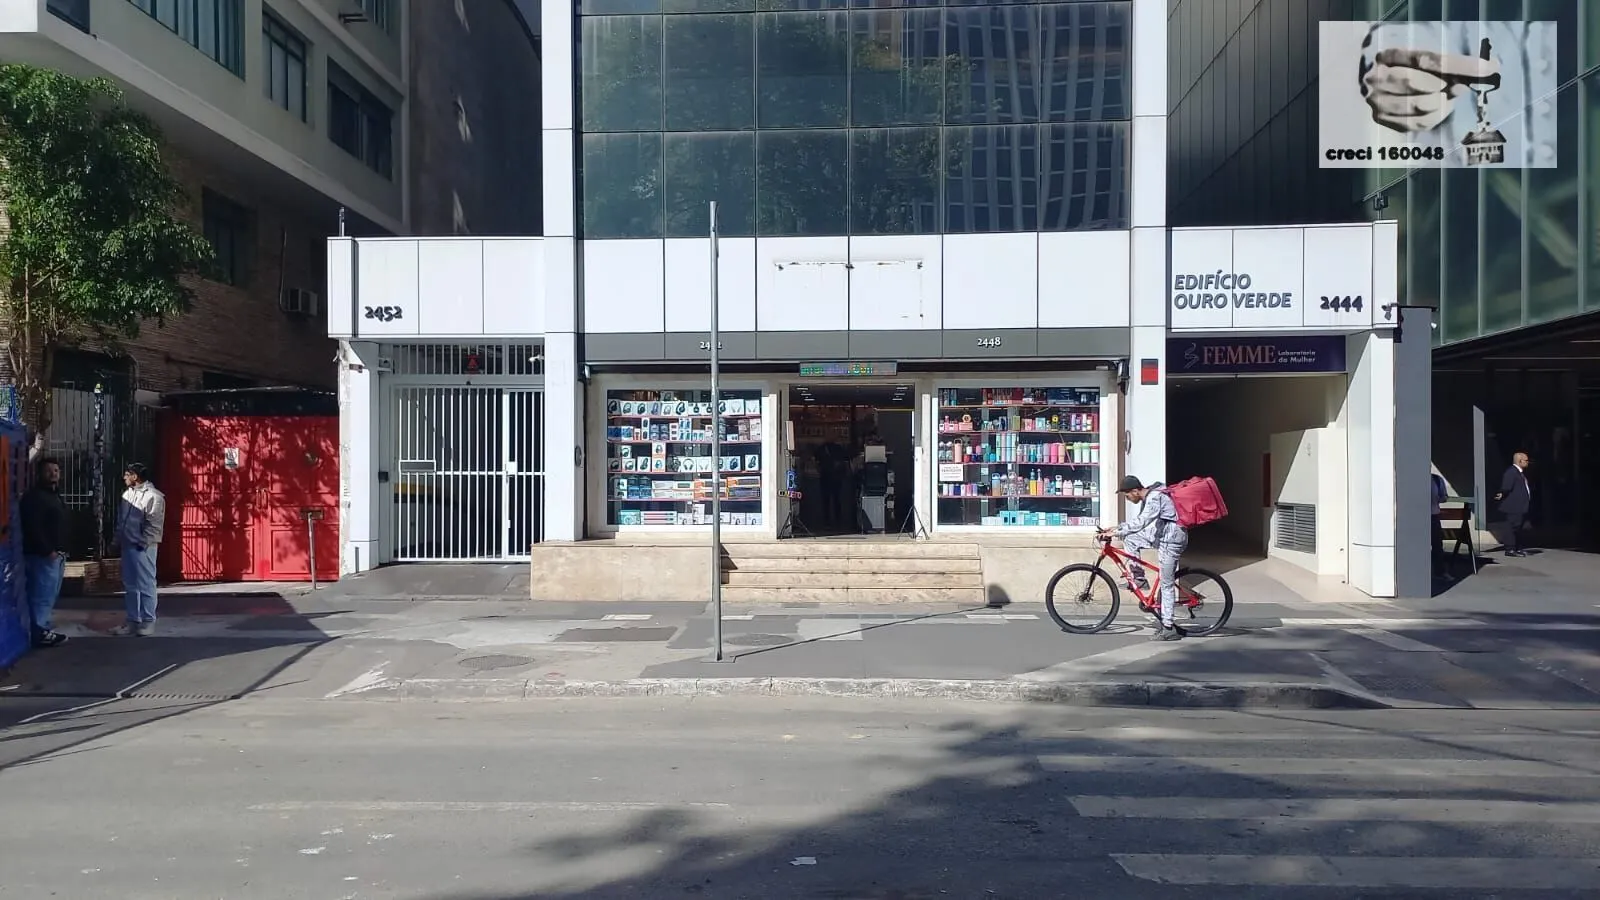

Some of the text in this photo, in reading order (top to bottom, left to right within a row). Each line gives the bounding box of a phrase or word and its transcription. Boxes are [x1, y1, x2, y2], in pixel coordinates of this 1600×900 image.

[1174, 269, 1251, 290] EDIFÍCIO
[1174, 292, 1292, 309] OURO VERDE
[1319, 295, 1363, 312] 2444
[364, 306, 403, 322] 2452
[977, 336, 1001, 347] 2448
[1203, 345, 1275, 365] FEMME
